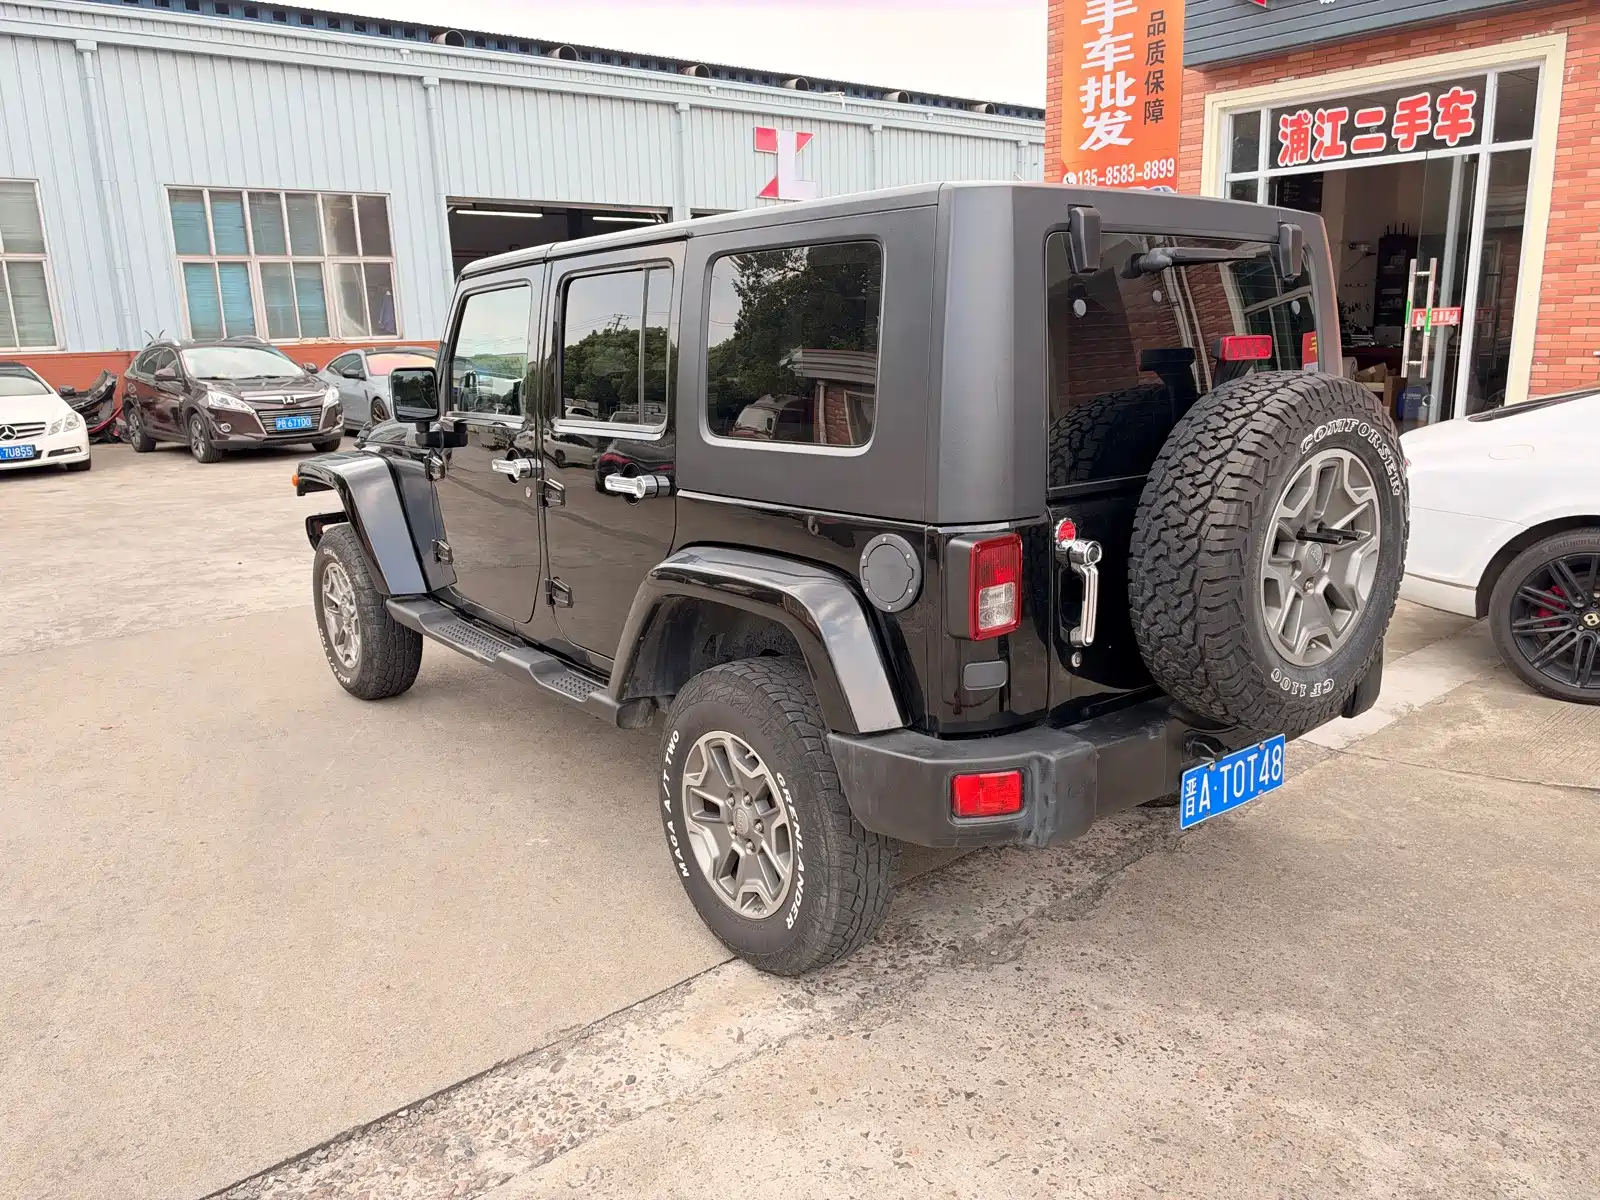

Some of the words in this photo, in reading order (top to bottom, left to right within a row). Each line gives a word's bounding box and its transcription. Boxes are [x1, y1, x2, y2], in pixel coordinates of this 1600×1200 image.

[1079, 0, 1138, 151] 手车批发
[1144, 9, 1166, 126] 品质保障
[1278, 86, 1476, 167] 浦江二手车
[1077, 157, 1175, 187] 135-8583-8899
[665, 730, 680, 766] TWO
[663, 769, 672, 814] A/T
[667, 820, 690, 877] MAGA
[776, 772, 805, 930] GRENLANDER
